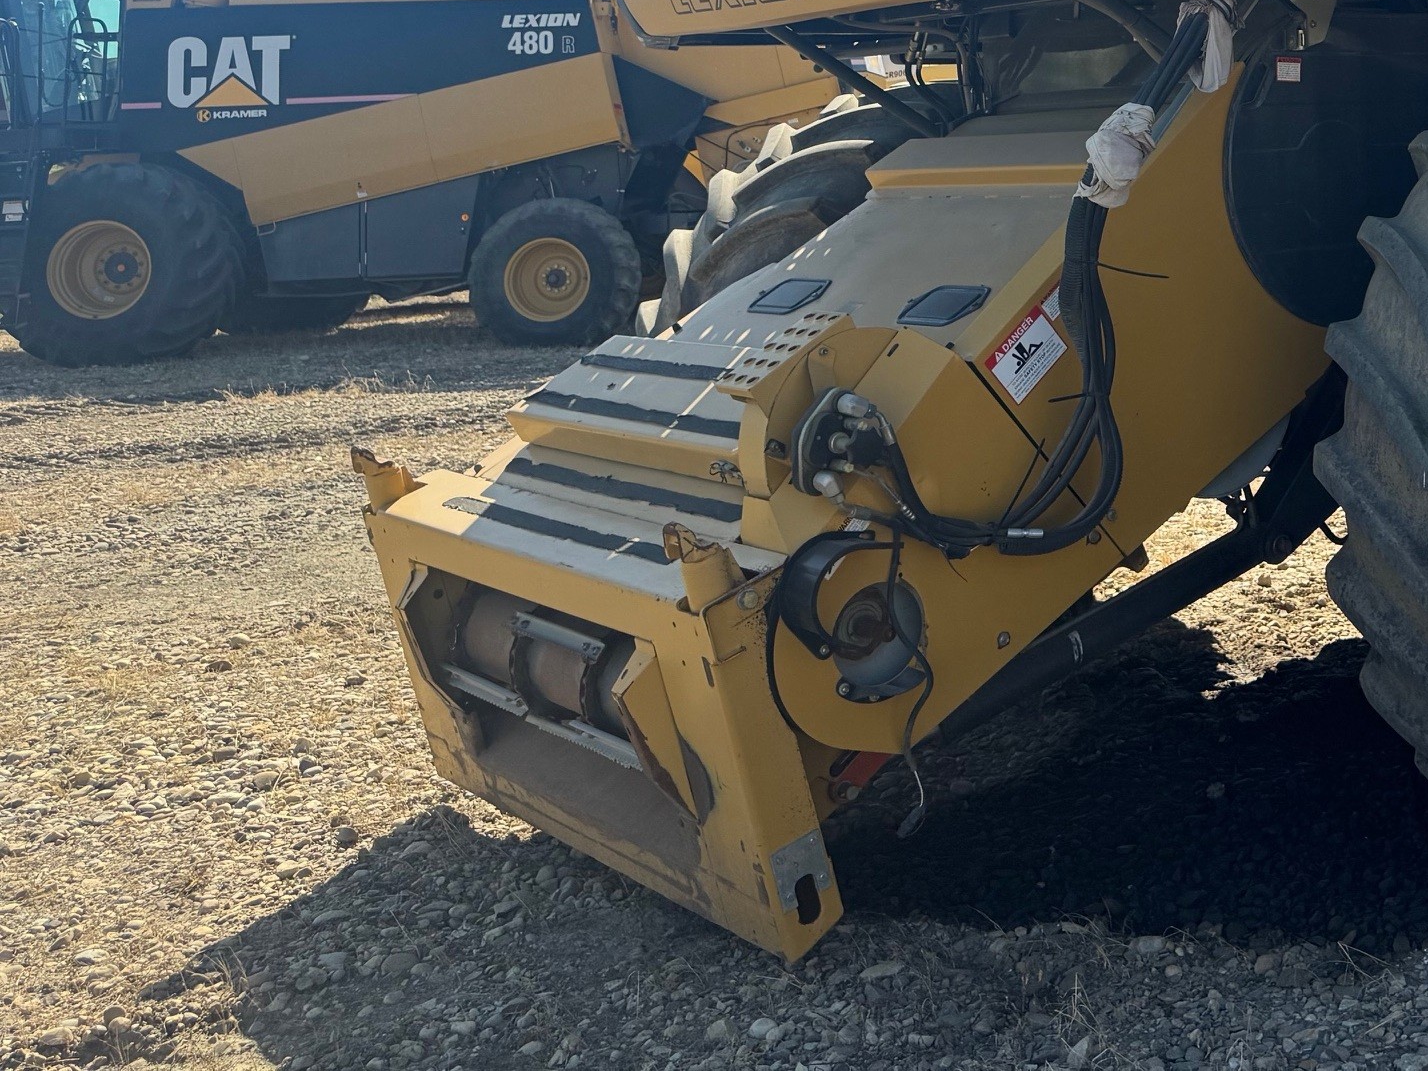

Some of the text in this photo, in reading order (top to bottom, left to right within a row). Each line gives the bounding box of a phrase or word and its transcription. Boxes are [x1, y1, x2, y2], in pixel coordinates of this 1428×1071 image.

[501, 13, 581, 28] LEXION
[507, 30, 575, 55] 480 R
[167, 35, 291, 109] CAT
[213, 109, 267, 119] KRAMER
[1001, 316, 1034, 350] DANGER
